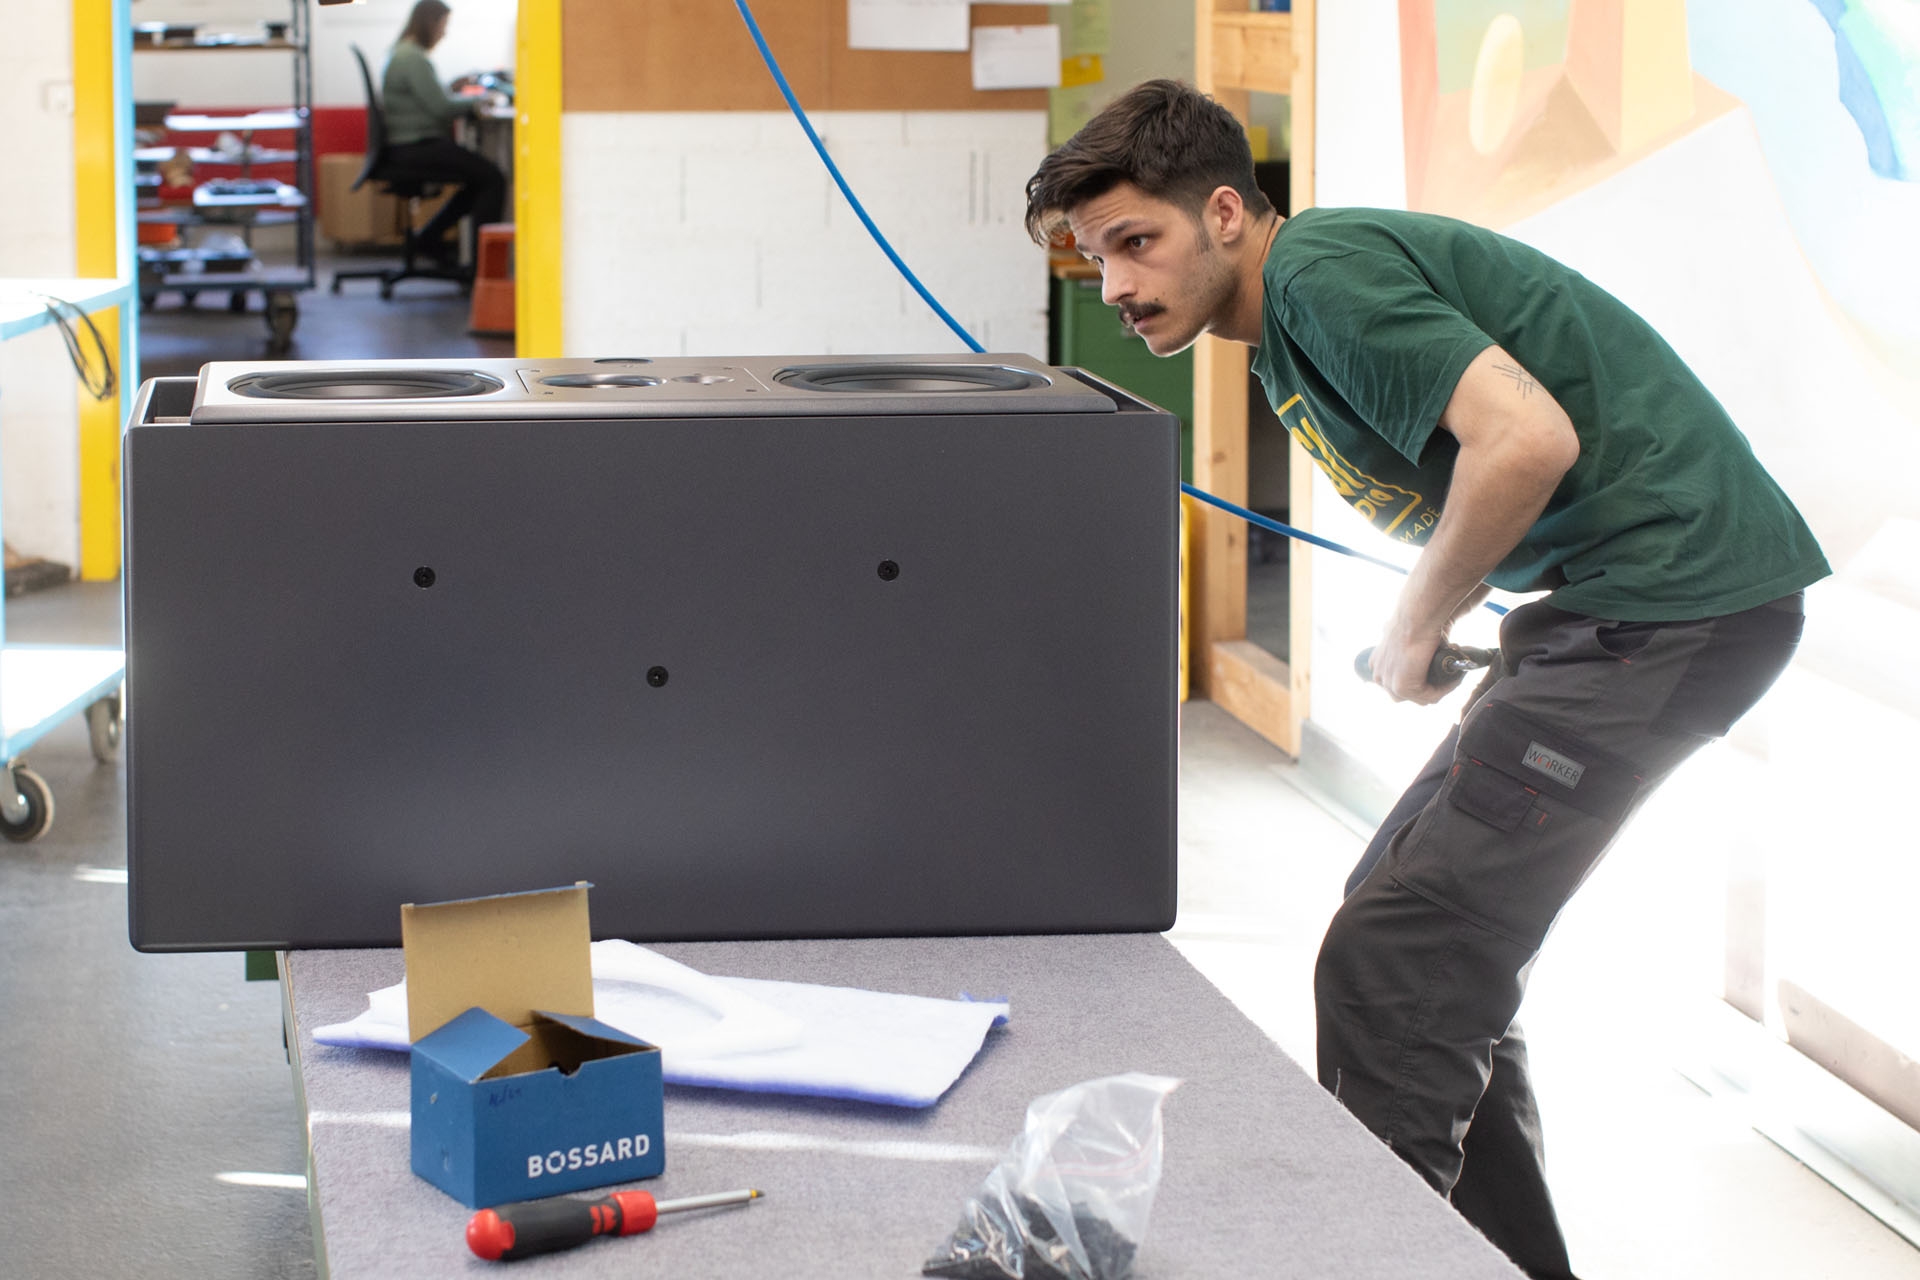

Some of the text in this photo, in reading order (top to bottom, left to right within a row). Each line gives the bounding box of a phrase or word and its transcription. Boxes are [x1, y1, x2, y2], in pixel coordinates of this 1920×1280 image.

[1399, 506, 1441, 543] MADE
[1528, 751, 1580, 781] WORKER
[527, 1133, 650, 1179] BOSSARD
